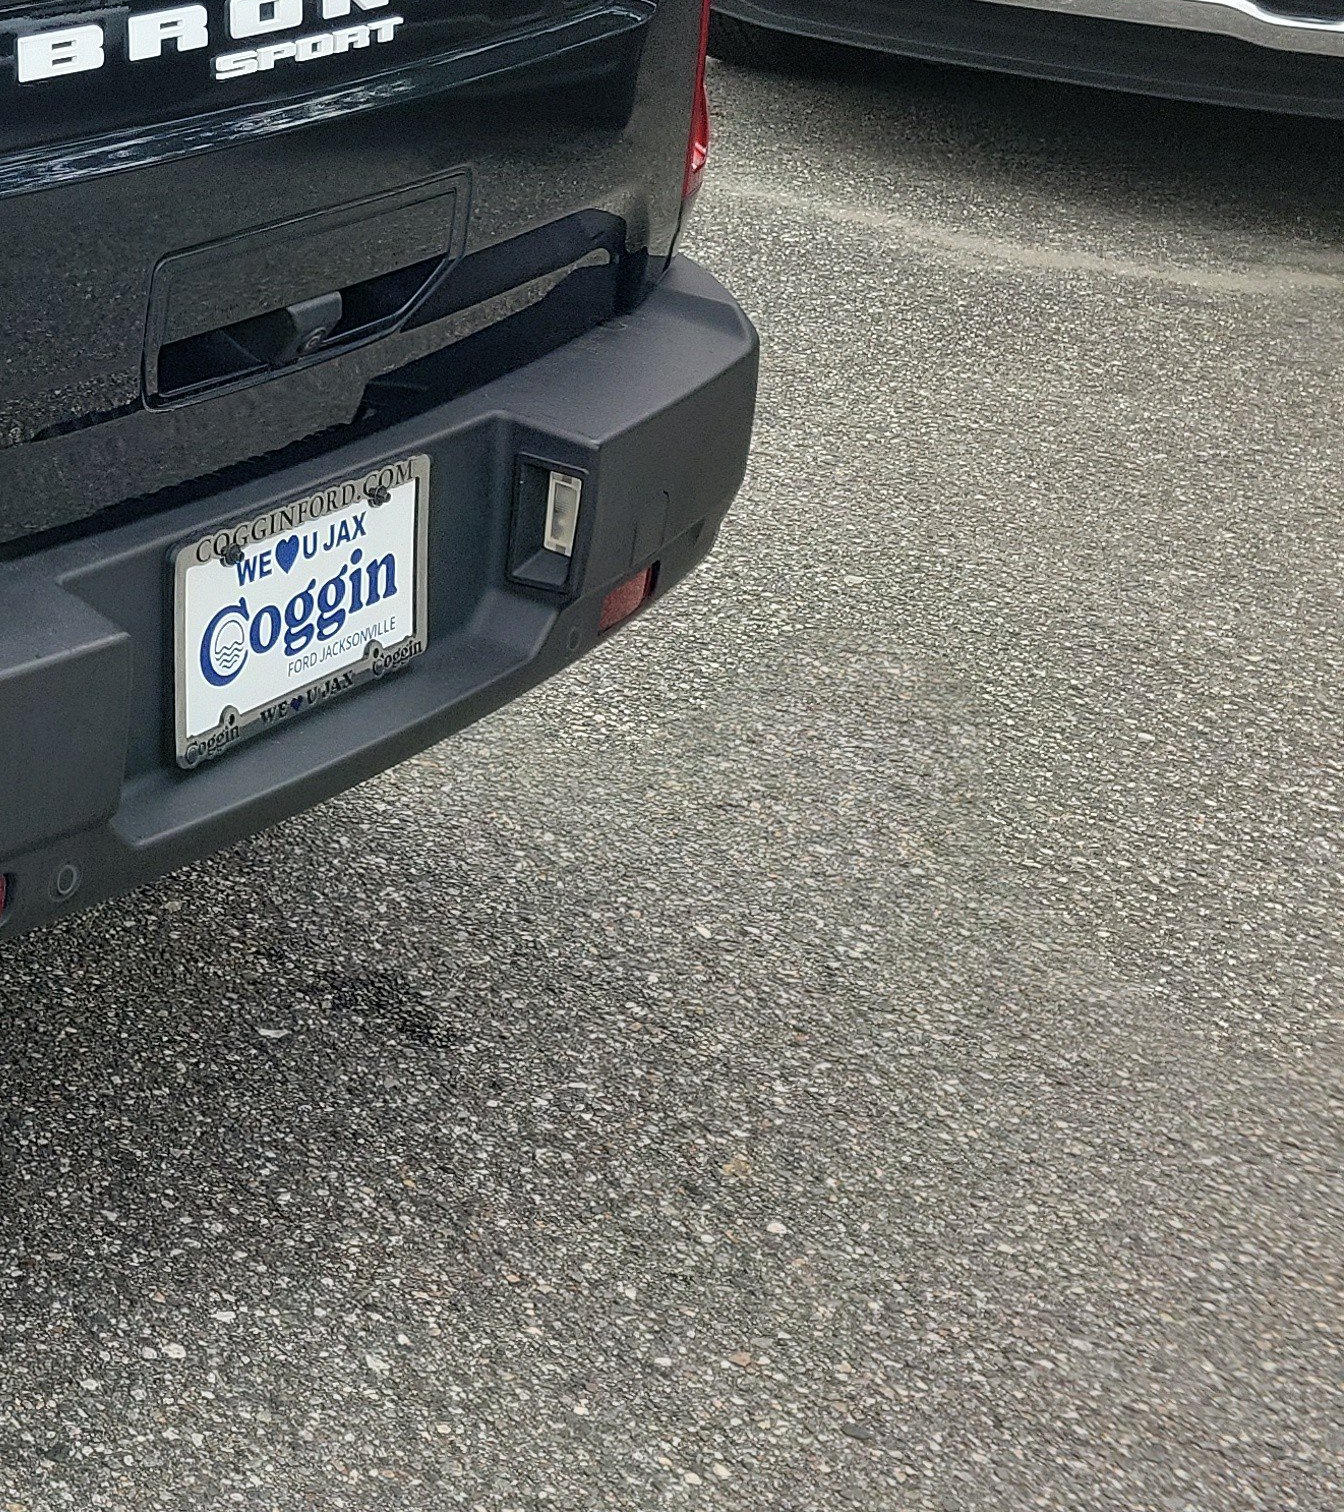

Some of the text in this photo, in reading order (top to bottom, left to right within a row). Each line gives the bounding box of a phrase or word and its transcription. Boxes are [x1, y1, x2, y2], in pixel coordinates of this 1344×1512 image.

[214, 16, 404, 80] SPORT
[196, 460, 414, 564] COGGINFORD.COM
[237, 511, 368, 587] WE U JAX
[200, 548, 398, 687] Coggin
[287, 616, 396, 677] FORD JACKSONVILLE
[372, 640, 423, 676] Coggin
[261, 669, 354, 723] WE U JAX
[185, 725, 240, 765] Coggin
